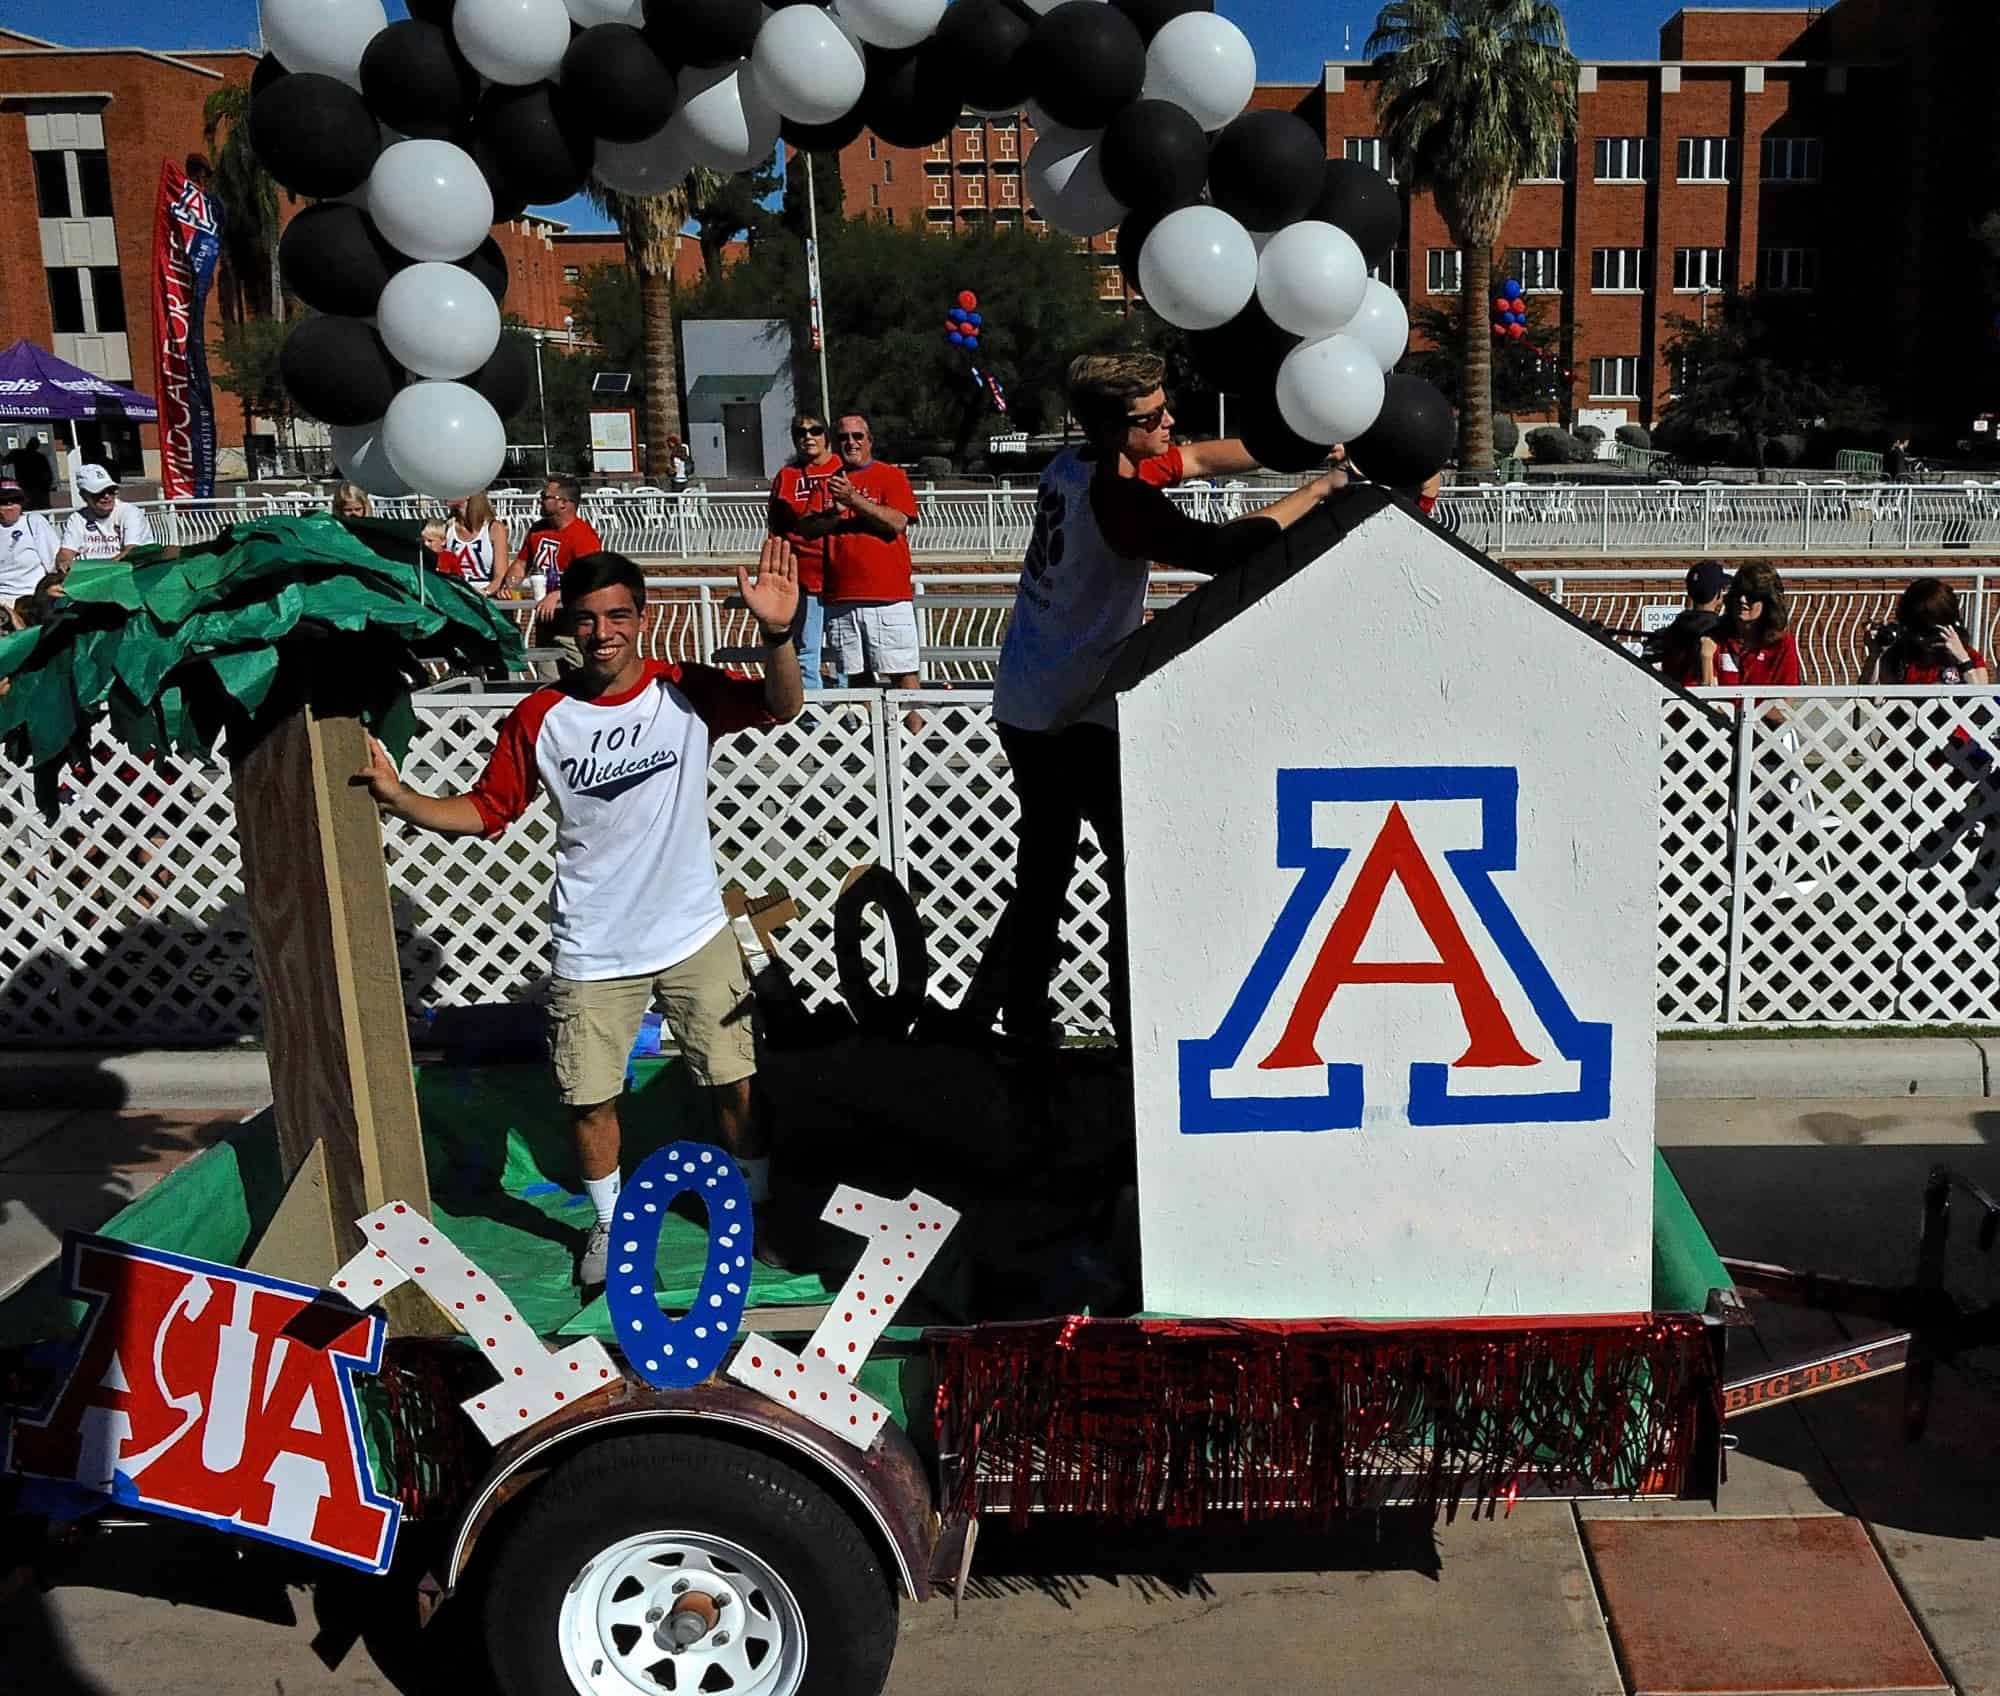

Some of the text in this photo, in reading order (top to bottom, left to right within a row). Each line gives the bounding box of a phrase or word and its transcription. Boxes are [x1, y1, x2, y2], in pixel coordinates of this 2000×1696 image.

[164, 292, 191, 361] FOR
[1648, 612, 1660, 622] DO
[590, 723, 642, 754] 101
[559, 749, 678, 790] Wildcats
[1177, 765, 1614, 1135] A
[1723, 1351, 1874, 1412] BIG-TEX
